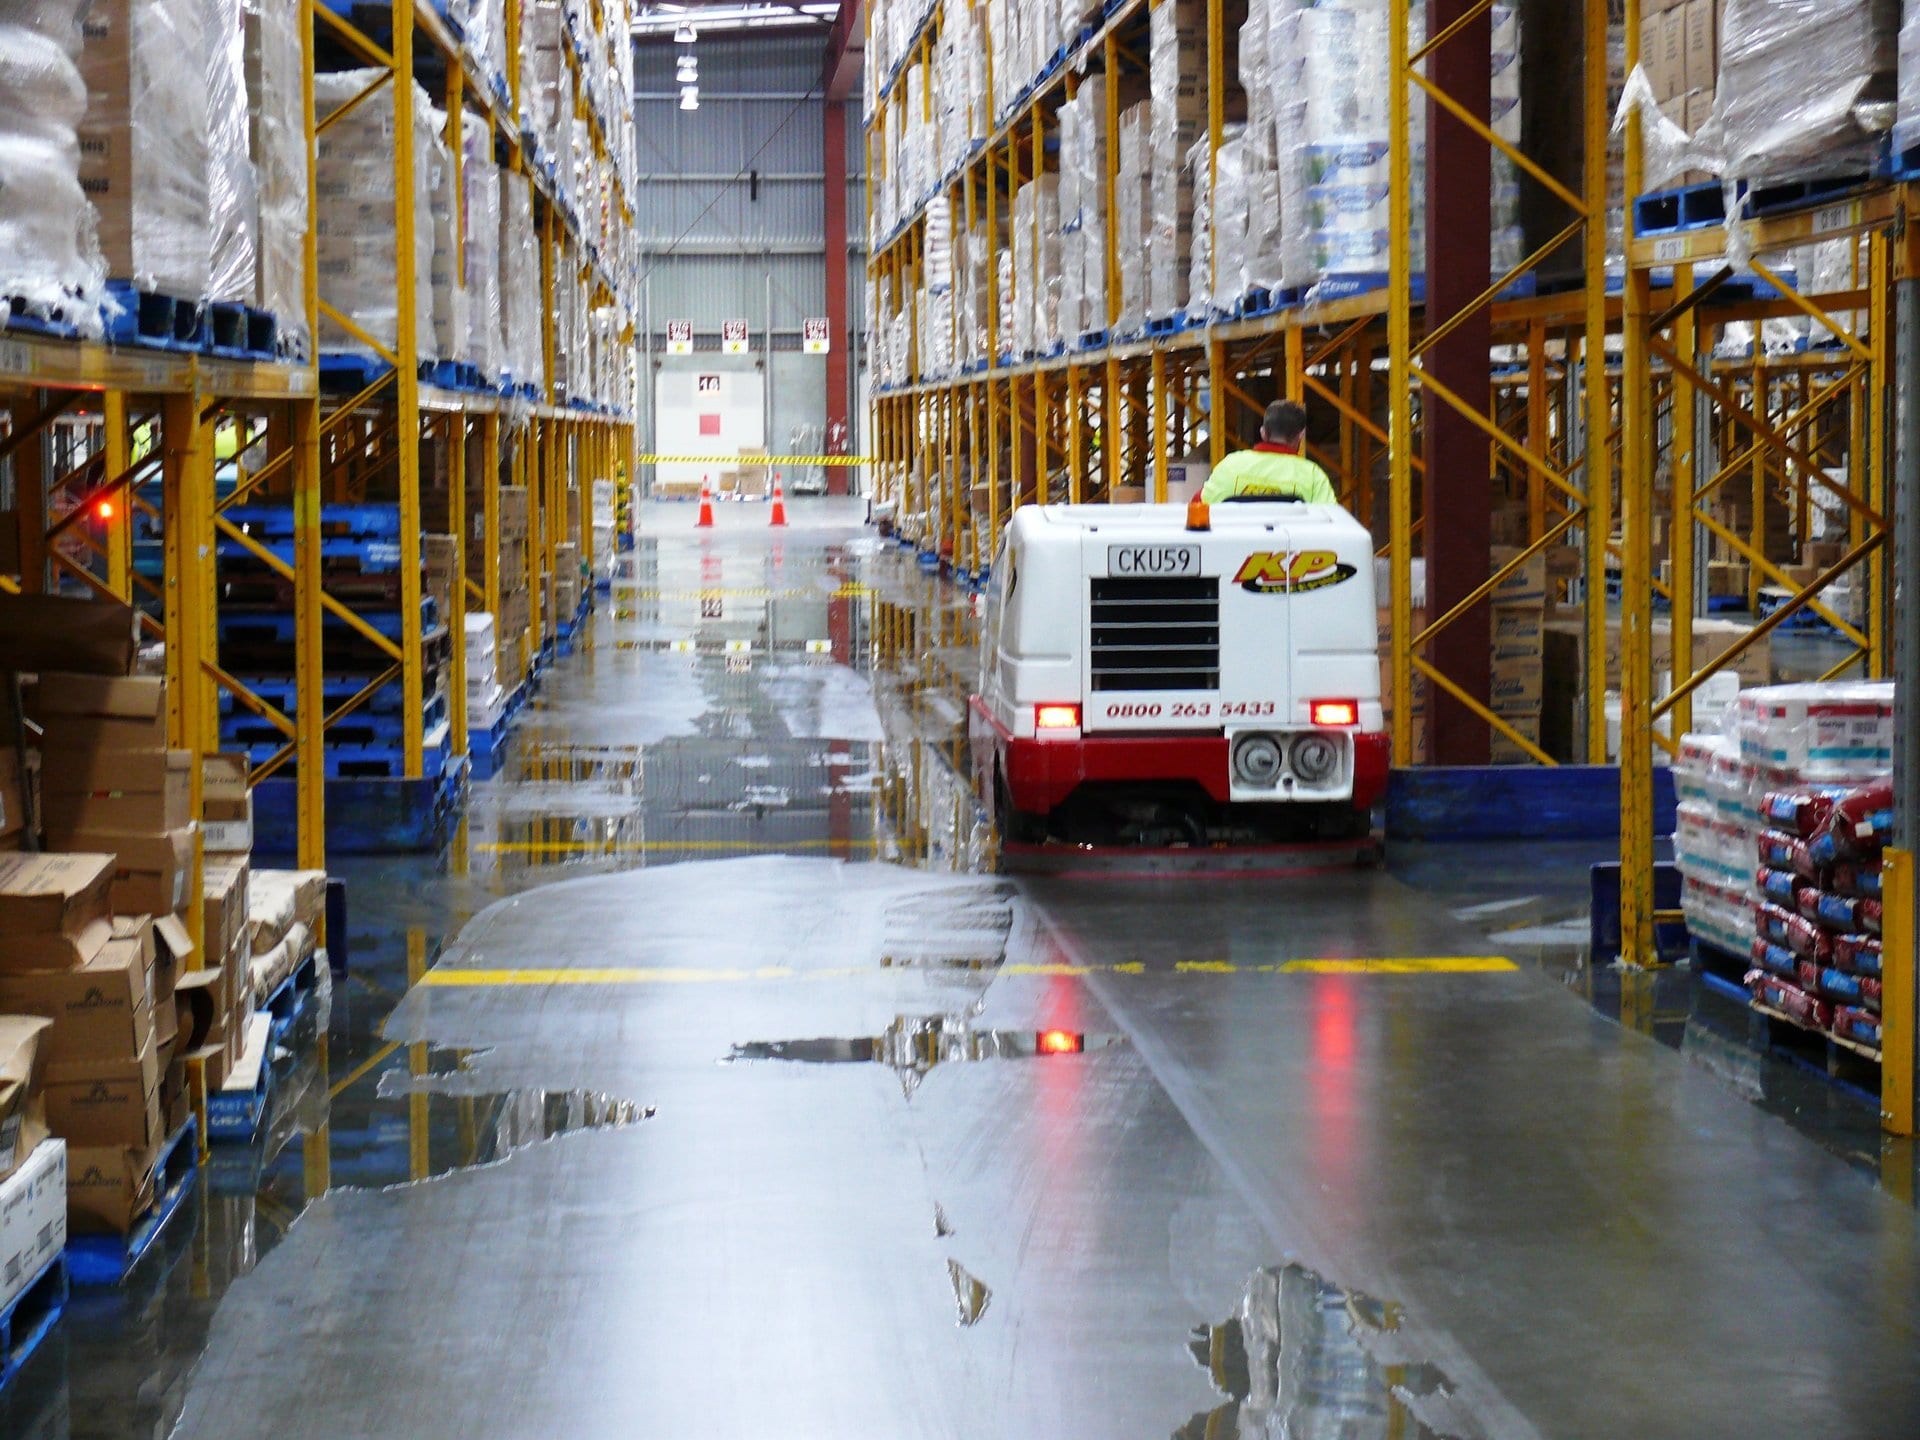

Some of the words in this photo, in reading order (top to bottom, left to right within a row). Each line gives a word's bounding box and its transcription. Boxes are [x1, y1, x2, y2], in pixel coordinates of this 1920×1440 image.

[1118, 548, 1191, 572] CKU59
[1231, 550, 1338, 583] KP
[1106, 702, 1162, 718] 0800
[1170, 702, 1211, 718] 263
[1219, 701, 1275, 717] 5433
